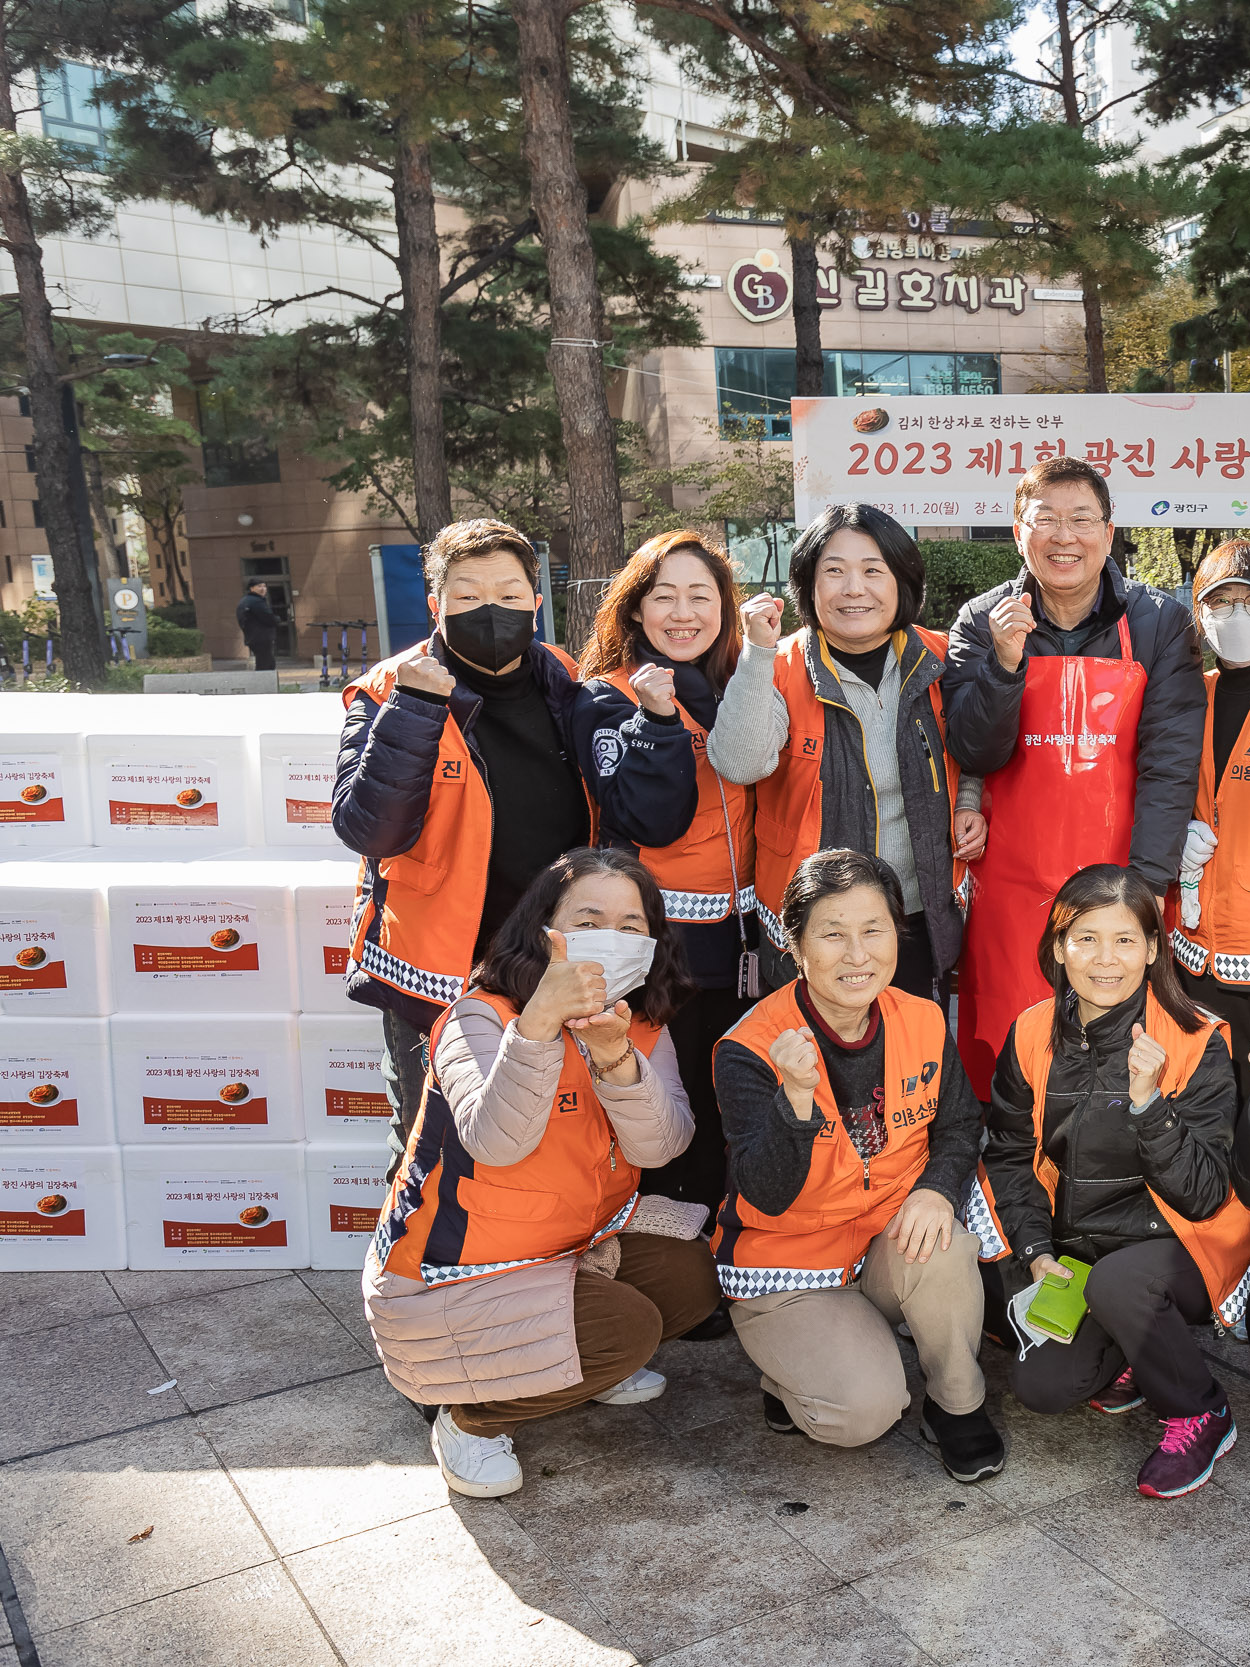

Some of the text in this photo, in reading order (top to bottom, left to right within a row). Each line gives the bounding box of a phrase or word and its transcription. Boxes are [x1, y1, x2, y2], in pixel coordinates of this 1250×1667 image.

[898, 415, 1064, 431] 김치 한상자로 전하는 안부
[848, 442, 953, 477] 2023
[966, 437, 1067, 479] 제1회
[1083, 437, 1156, 479] 광진
[902, 503, 920, 515] 11.
[923, 501, 960, 517] 20(월)
[1173, 503, 1209, 514] 광진구
[631, 738, 655, 750] 1885
[1024, 733, 1117, 746] 광진 사랑의 김장축제
[441, 760, 462, 779] 진
[127, 775, 145, 784] 제1회
[146, 776, 160, 784] 광진
[161, 776, 182, 784] 사랑의
[184, 776, 211, 785] 김장축제
[135, 913, 249, 925] 2023 제1회 광진 사랑의 김장축제
[325, 918, 342, 926] 2023
[23, 931, 56, 942] 김장축제
[328, 1061, 346, 1069] 2023
[346, 1061, 366, 1070] 제1회
[10, 1070, 35, 1080] 사랑의
[37, 1070, 70, 1080] 김장축제
[146, 1067, 260, 1078] 2023 제1회 광진 사랑의 김장축제
[557, 1091, 578, 1113] 진
[892, 1097, 938, 1129] 의용소방
[820, 1120, 837, 1139] 진
[2, 1180, 78, 1190] 광진 사랑의 김장축제
[333, 1177, 350, 1185] 2023
[350, 1177, 370, 1186] 제1회
[165, 1191, 279, 1202] 2023 제1회 광진 사랑의 김장축제
